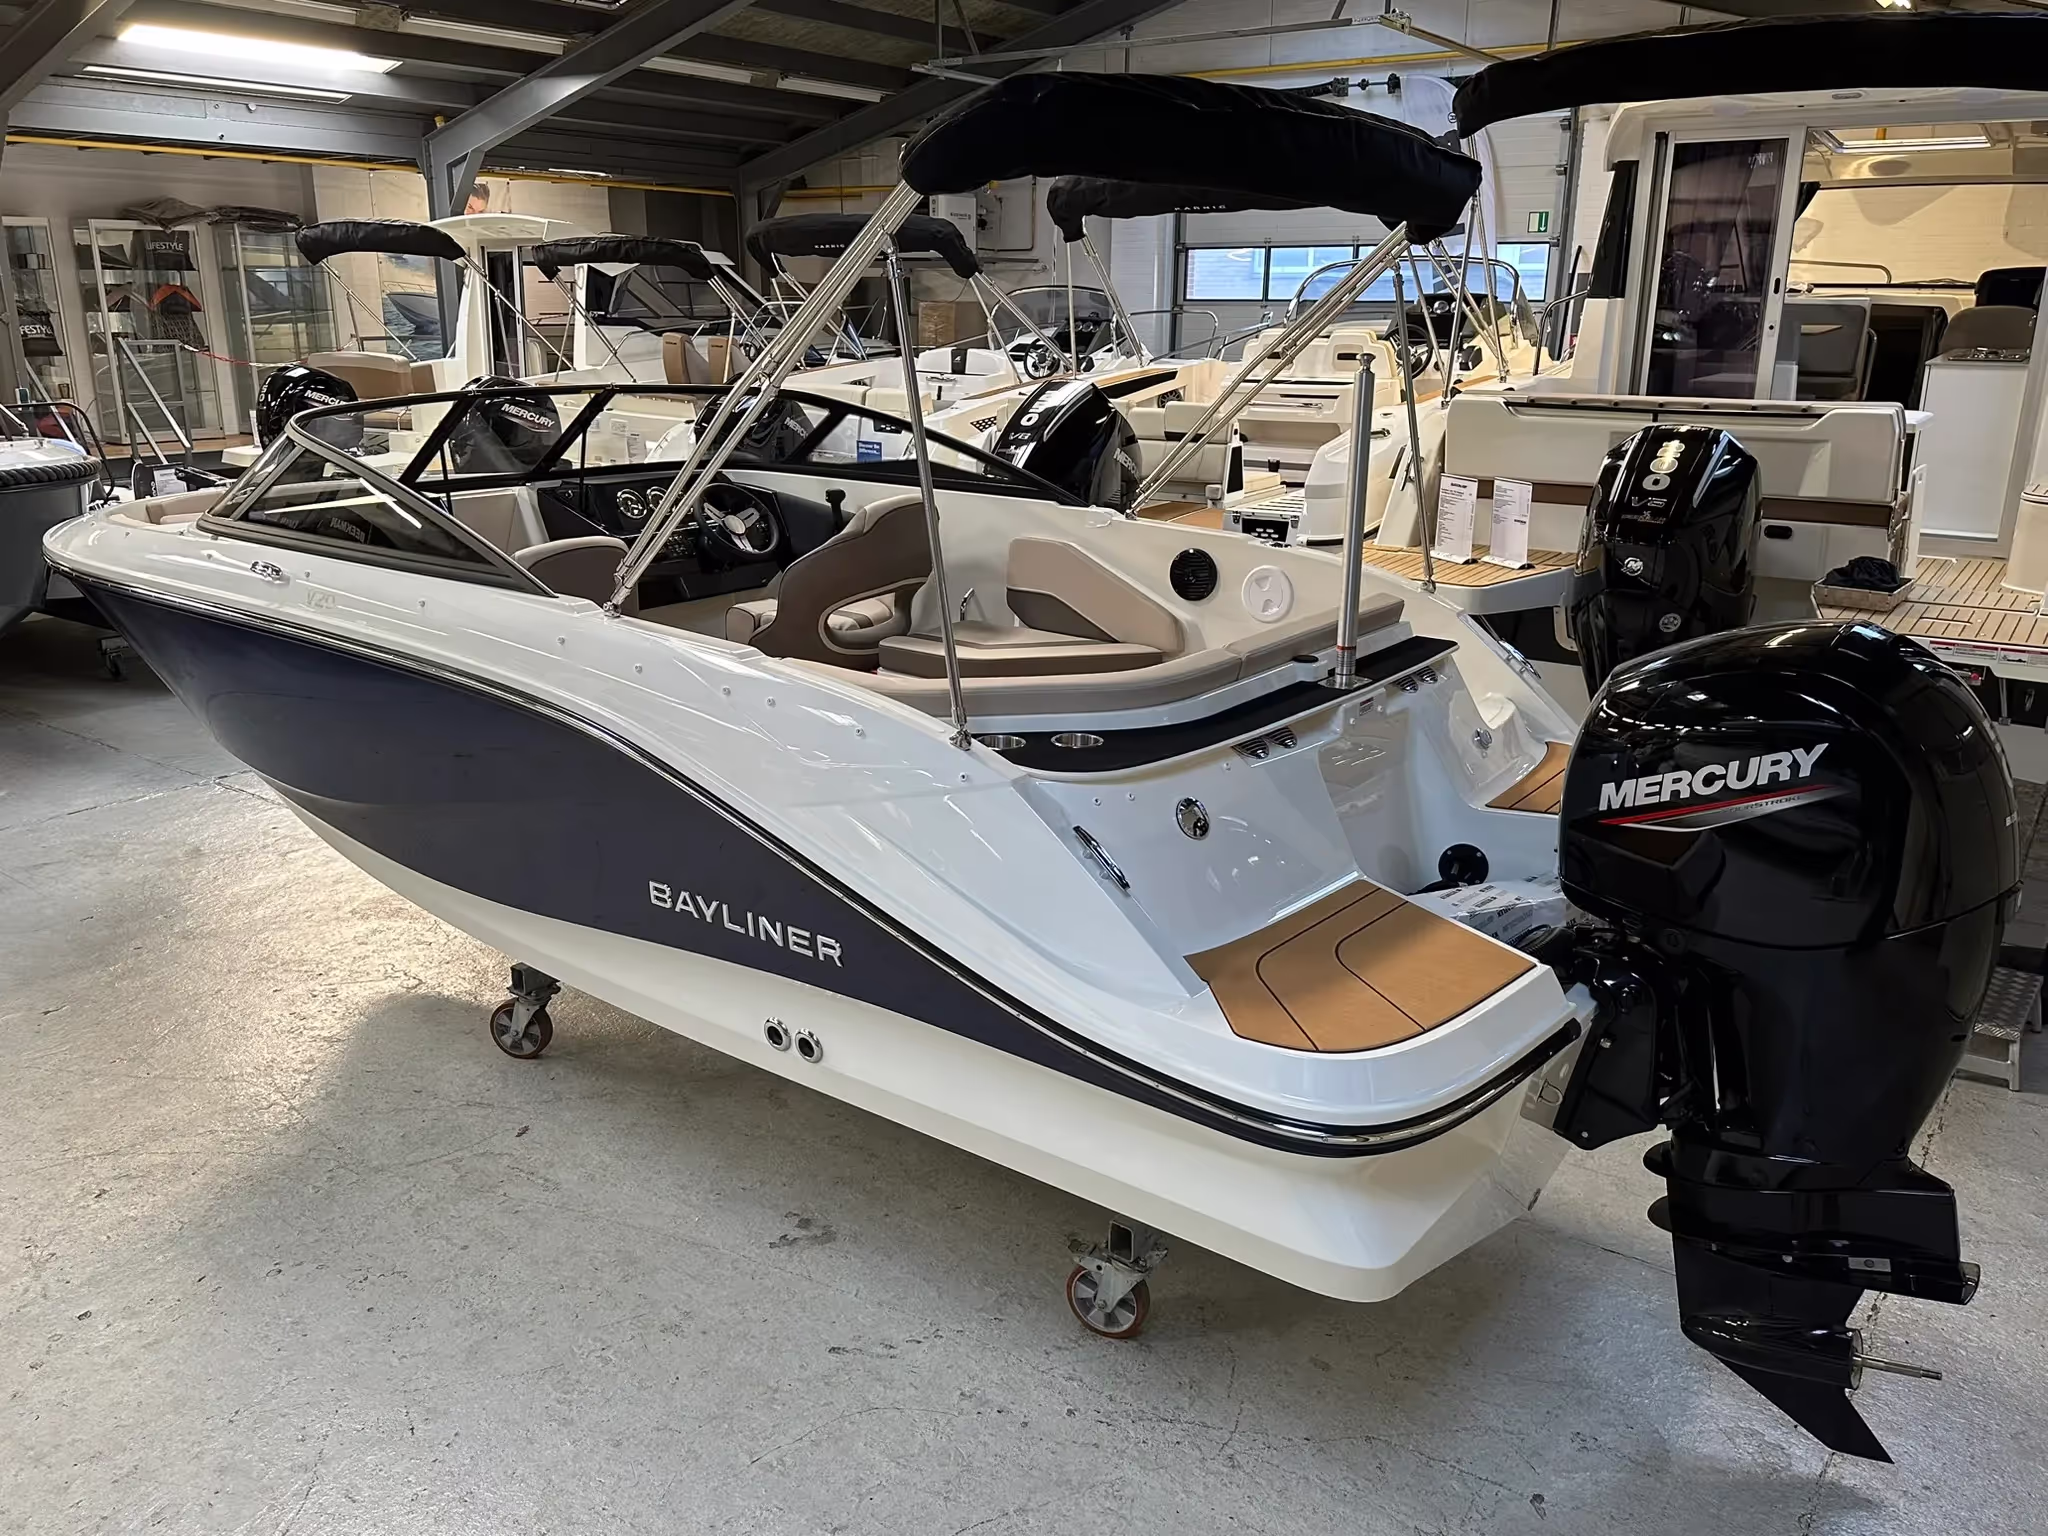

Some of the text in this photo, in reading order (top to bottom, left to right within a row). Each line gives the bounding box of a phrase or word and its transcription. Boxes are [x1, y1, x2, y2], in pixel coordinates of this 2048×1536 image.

[147, 241, 184, 251] LIFESTYLE
[501, 402, 556, 428] MERCURY
[1598, 742, 1830, 812] MERCURY
[648, 880, 844, 968] BAYLINER
